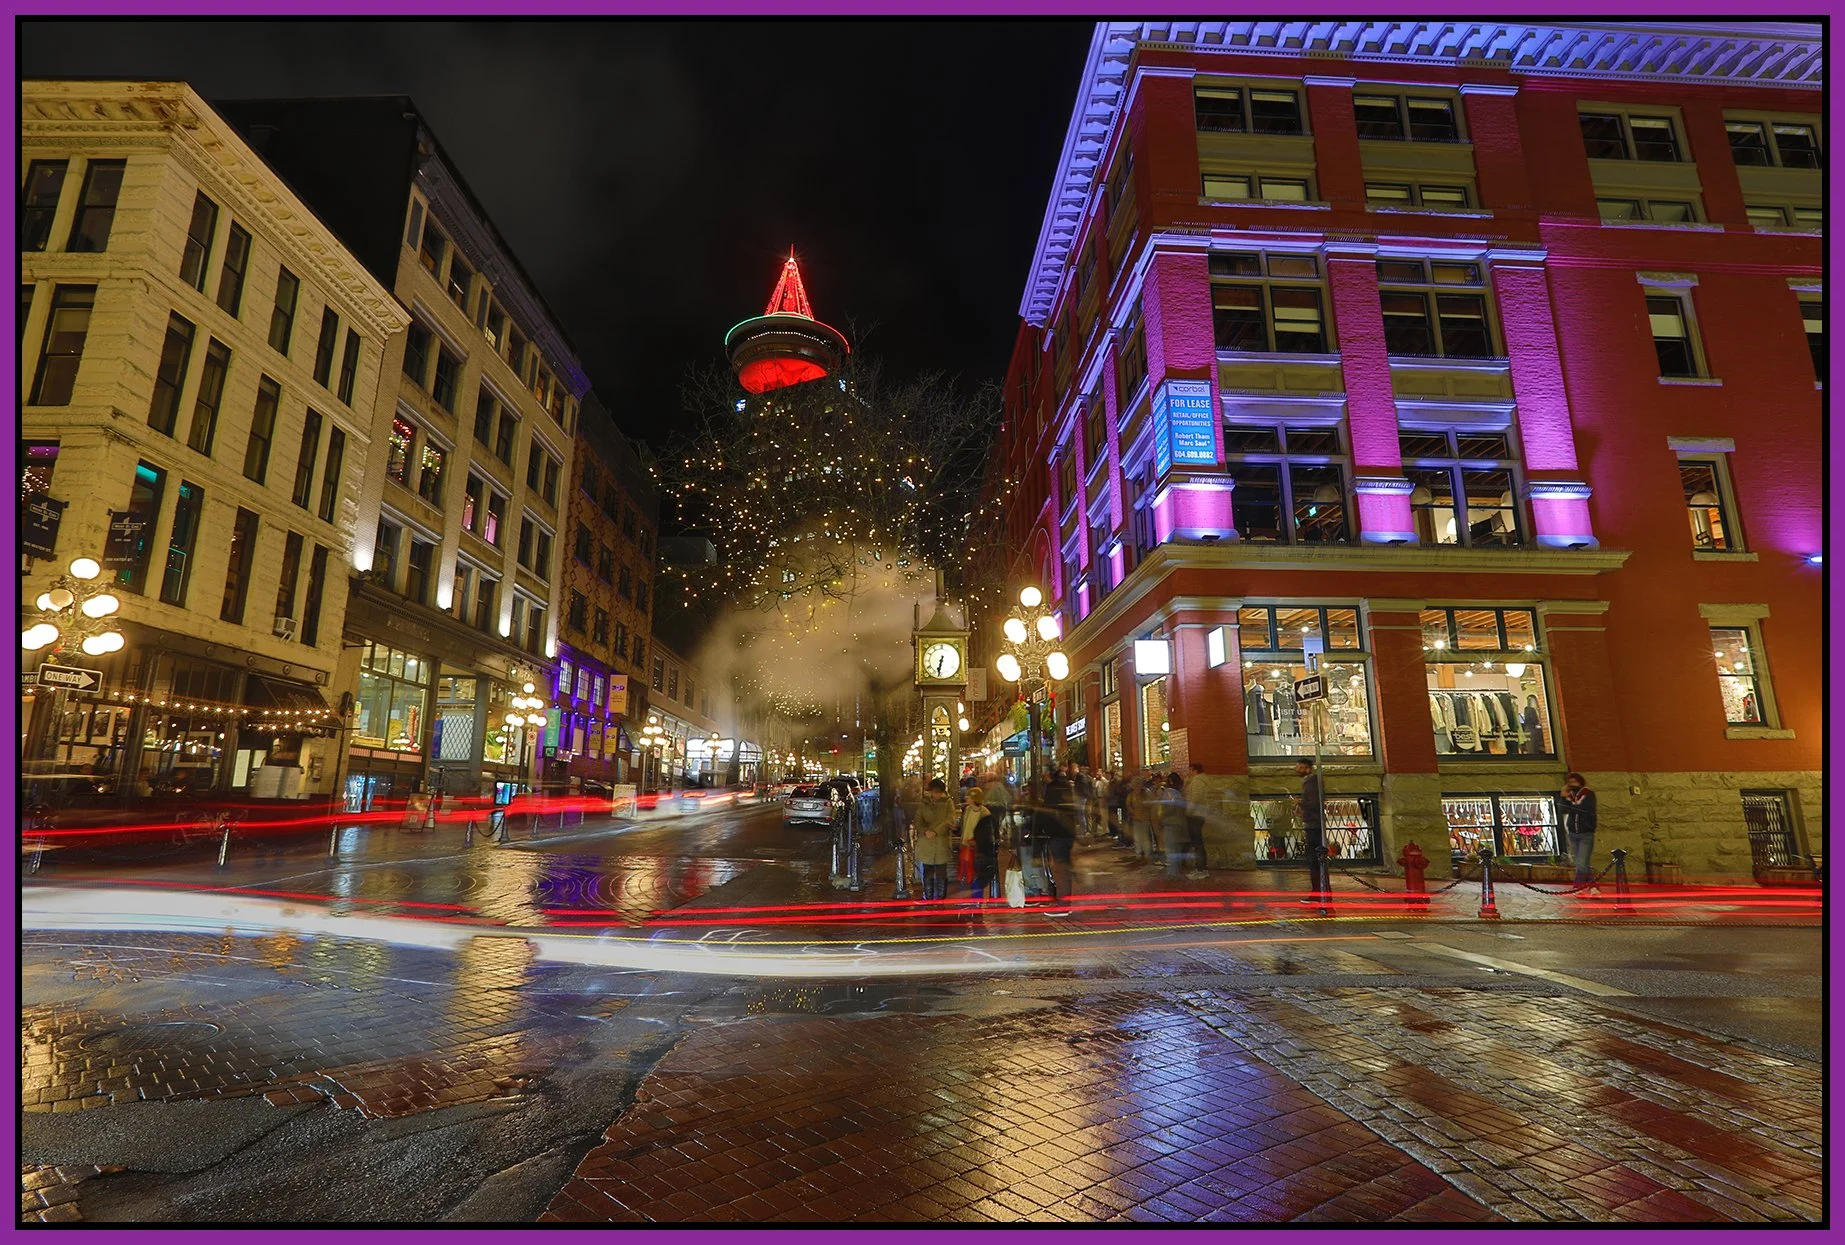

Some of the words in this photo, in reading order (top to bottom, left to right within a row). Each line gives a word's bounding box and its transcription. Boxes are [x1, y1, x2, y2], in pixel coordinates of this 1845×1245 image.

[1170, 399, 1186, 408] FOR
[1187, 399, 1210, 409] LEASE
[1174, 432, 1194, 440] Robert
[46, 672, 62, 681] ONE
[65, 673, 82, 684] WAY
